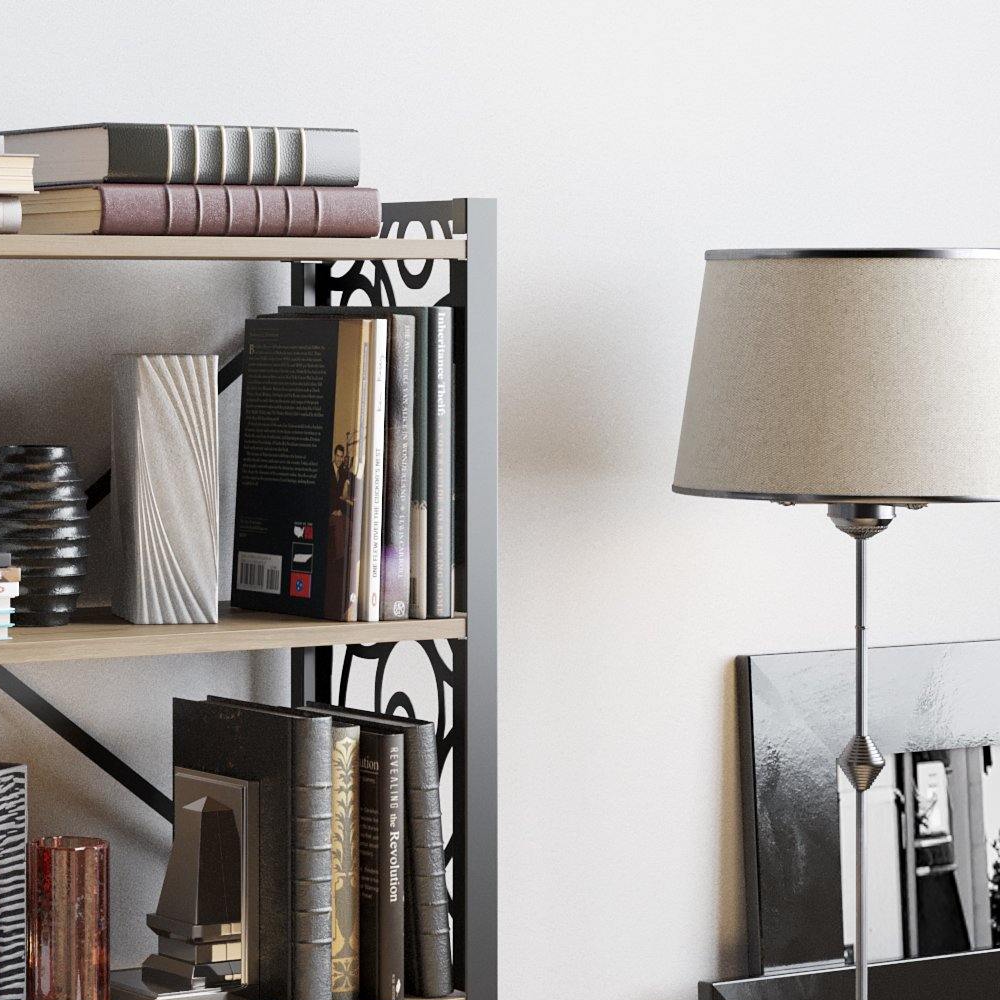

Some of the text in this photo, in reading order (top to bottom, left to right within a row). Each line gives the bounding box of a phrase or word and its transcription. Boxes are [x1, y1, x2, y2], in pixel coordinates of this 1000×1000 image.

[437, 312, 447, 380] Inheritance
[389, 747, 400, 903] REVEALING the Revolution
